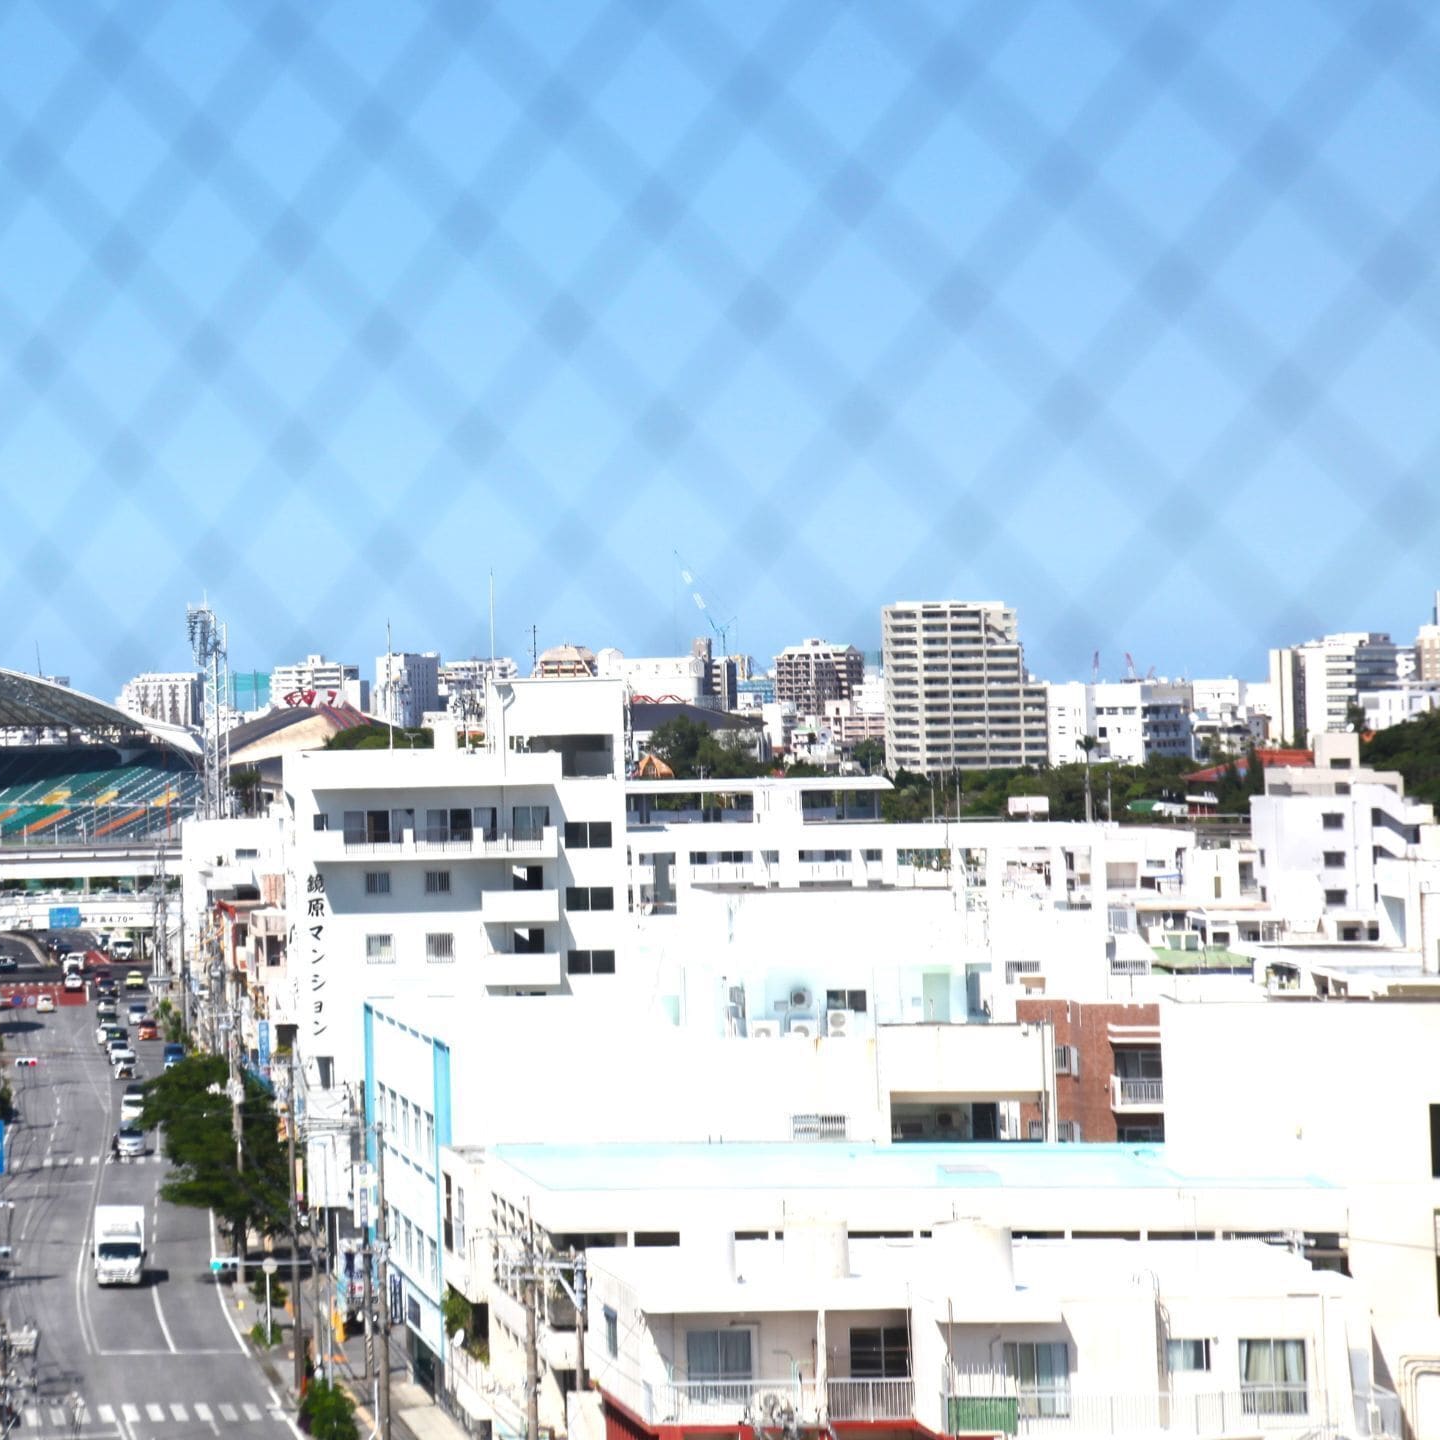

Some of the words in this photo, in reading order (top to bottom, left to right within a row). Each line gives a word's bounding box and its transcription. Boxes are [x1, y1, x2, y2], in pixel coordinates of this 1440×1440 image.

[306, 873, 327, 1036] 鏡原マンション
